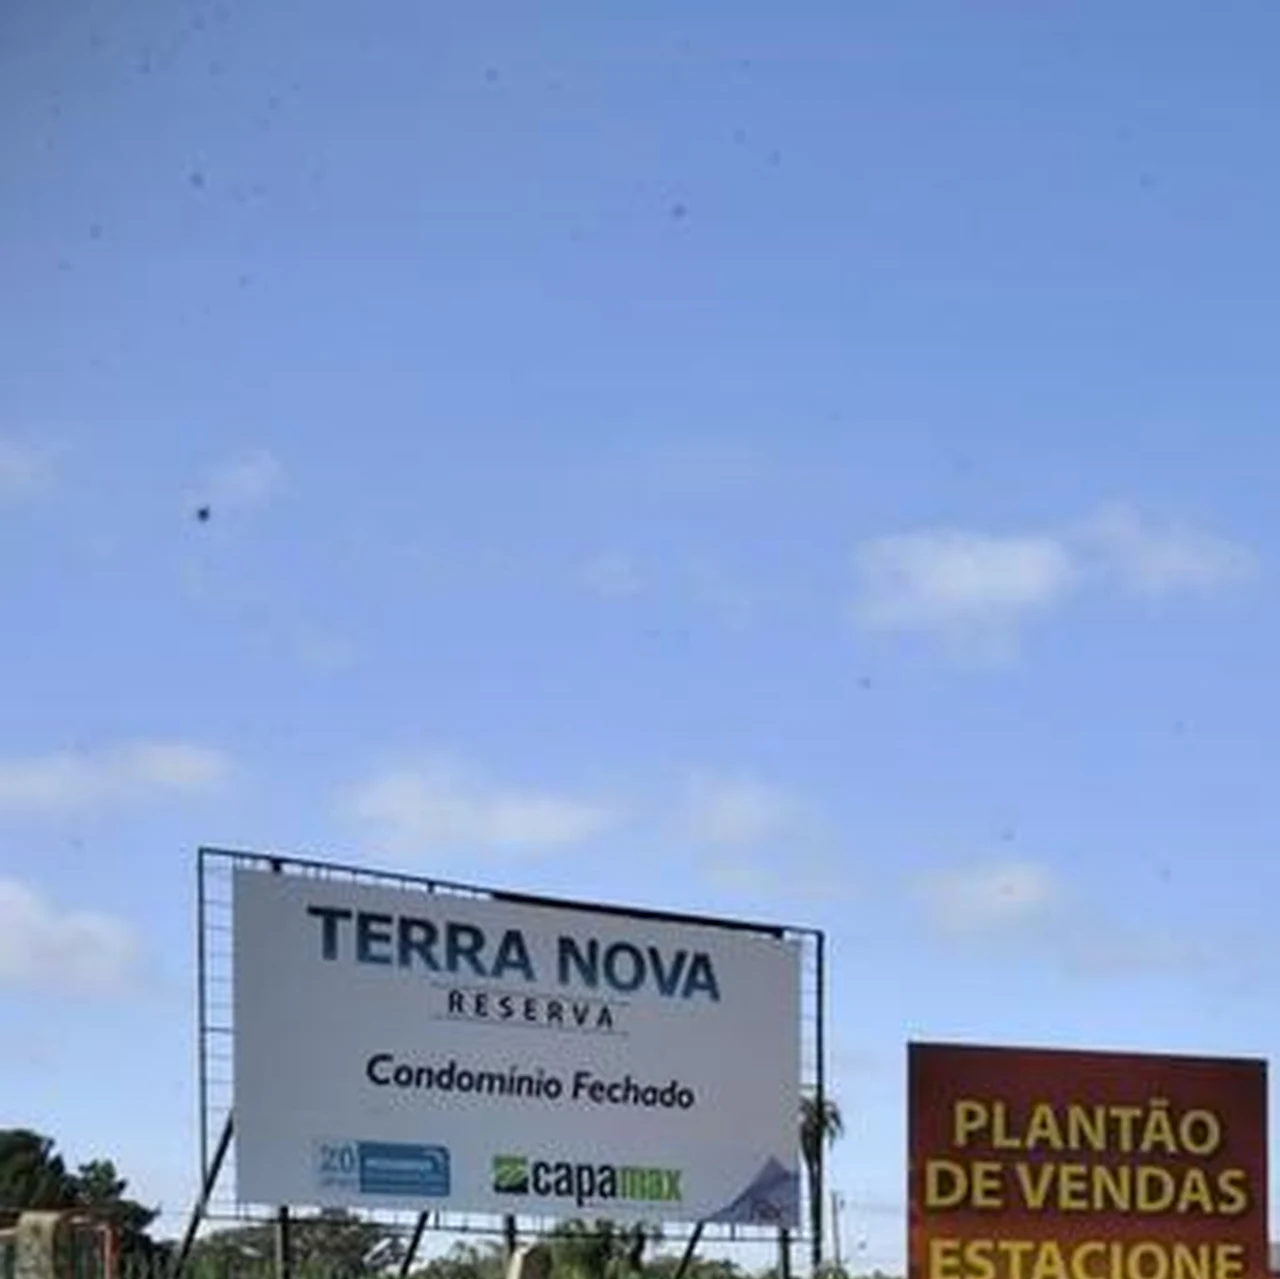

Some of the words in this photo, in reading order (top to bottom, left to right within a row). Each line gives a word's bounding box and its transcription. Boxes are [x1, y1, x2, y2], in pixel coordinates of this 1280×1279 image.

[308, 906, 536, 982] TERRA
[557, 936, 721, 1002] NOVA
[448, 989, 615, 1029] RESERVA
[366, 1055, 562, 1100] Condomínio
[572, 1072, 696, 1109] Fechado
[954, 1099, 1221, 1155] PLANTÃO
[531, 1158, 682, 1206] capamax
[925, 1159, 1002, 1206] DE
[1016, 1165, 1247, 1213] VENDAS
